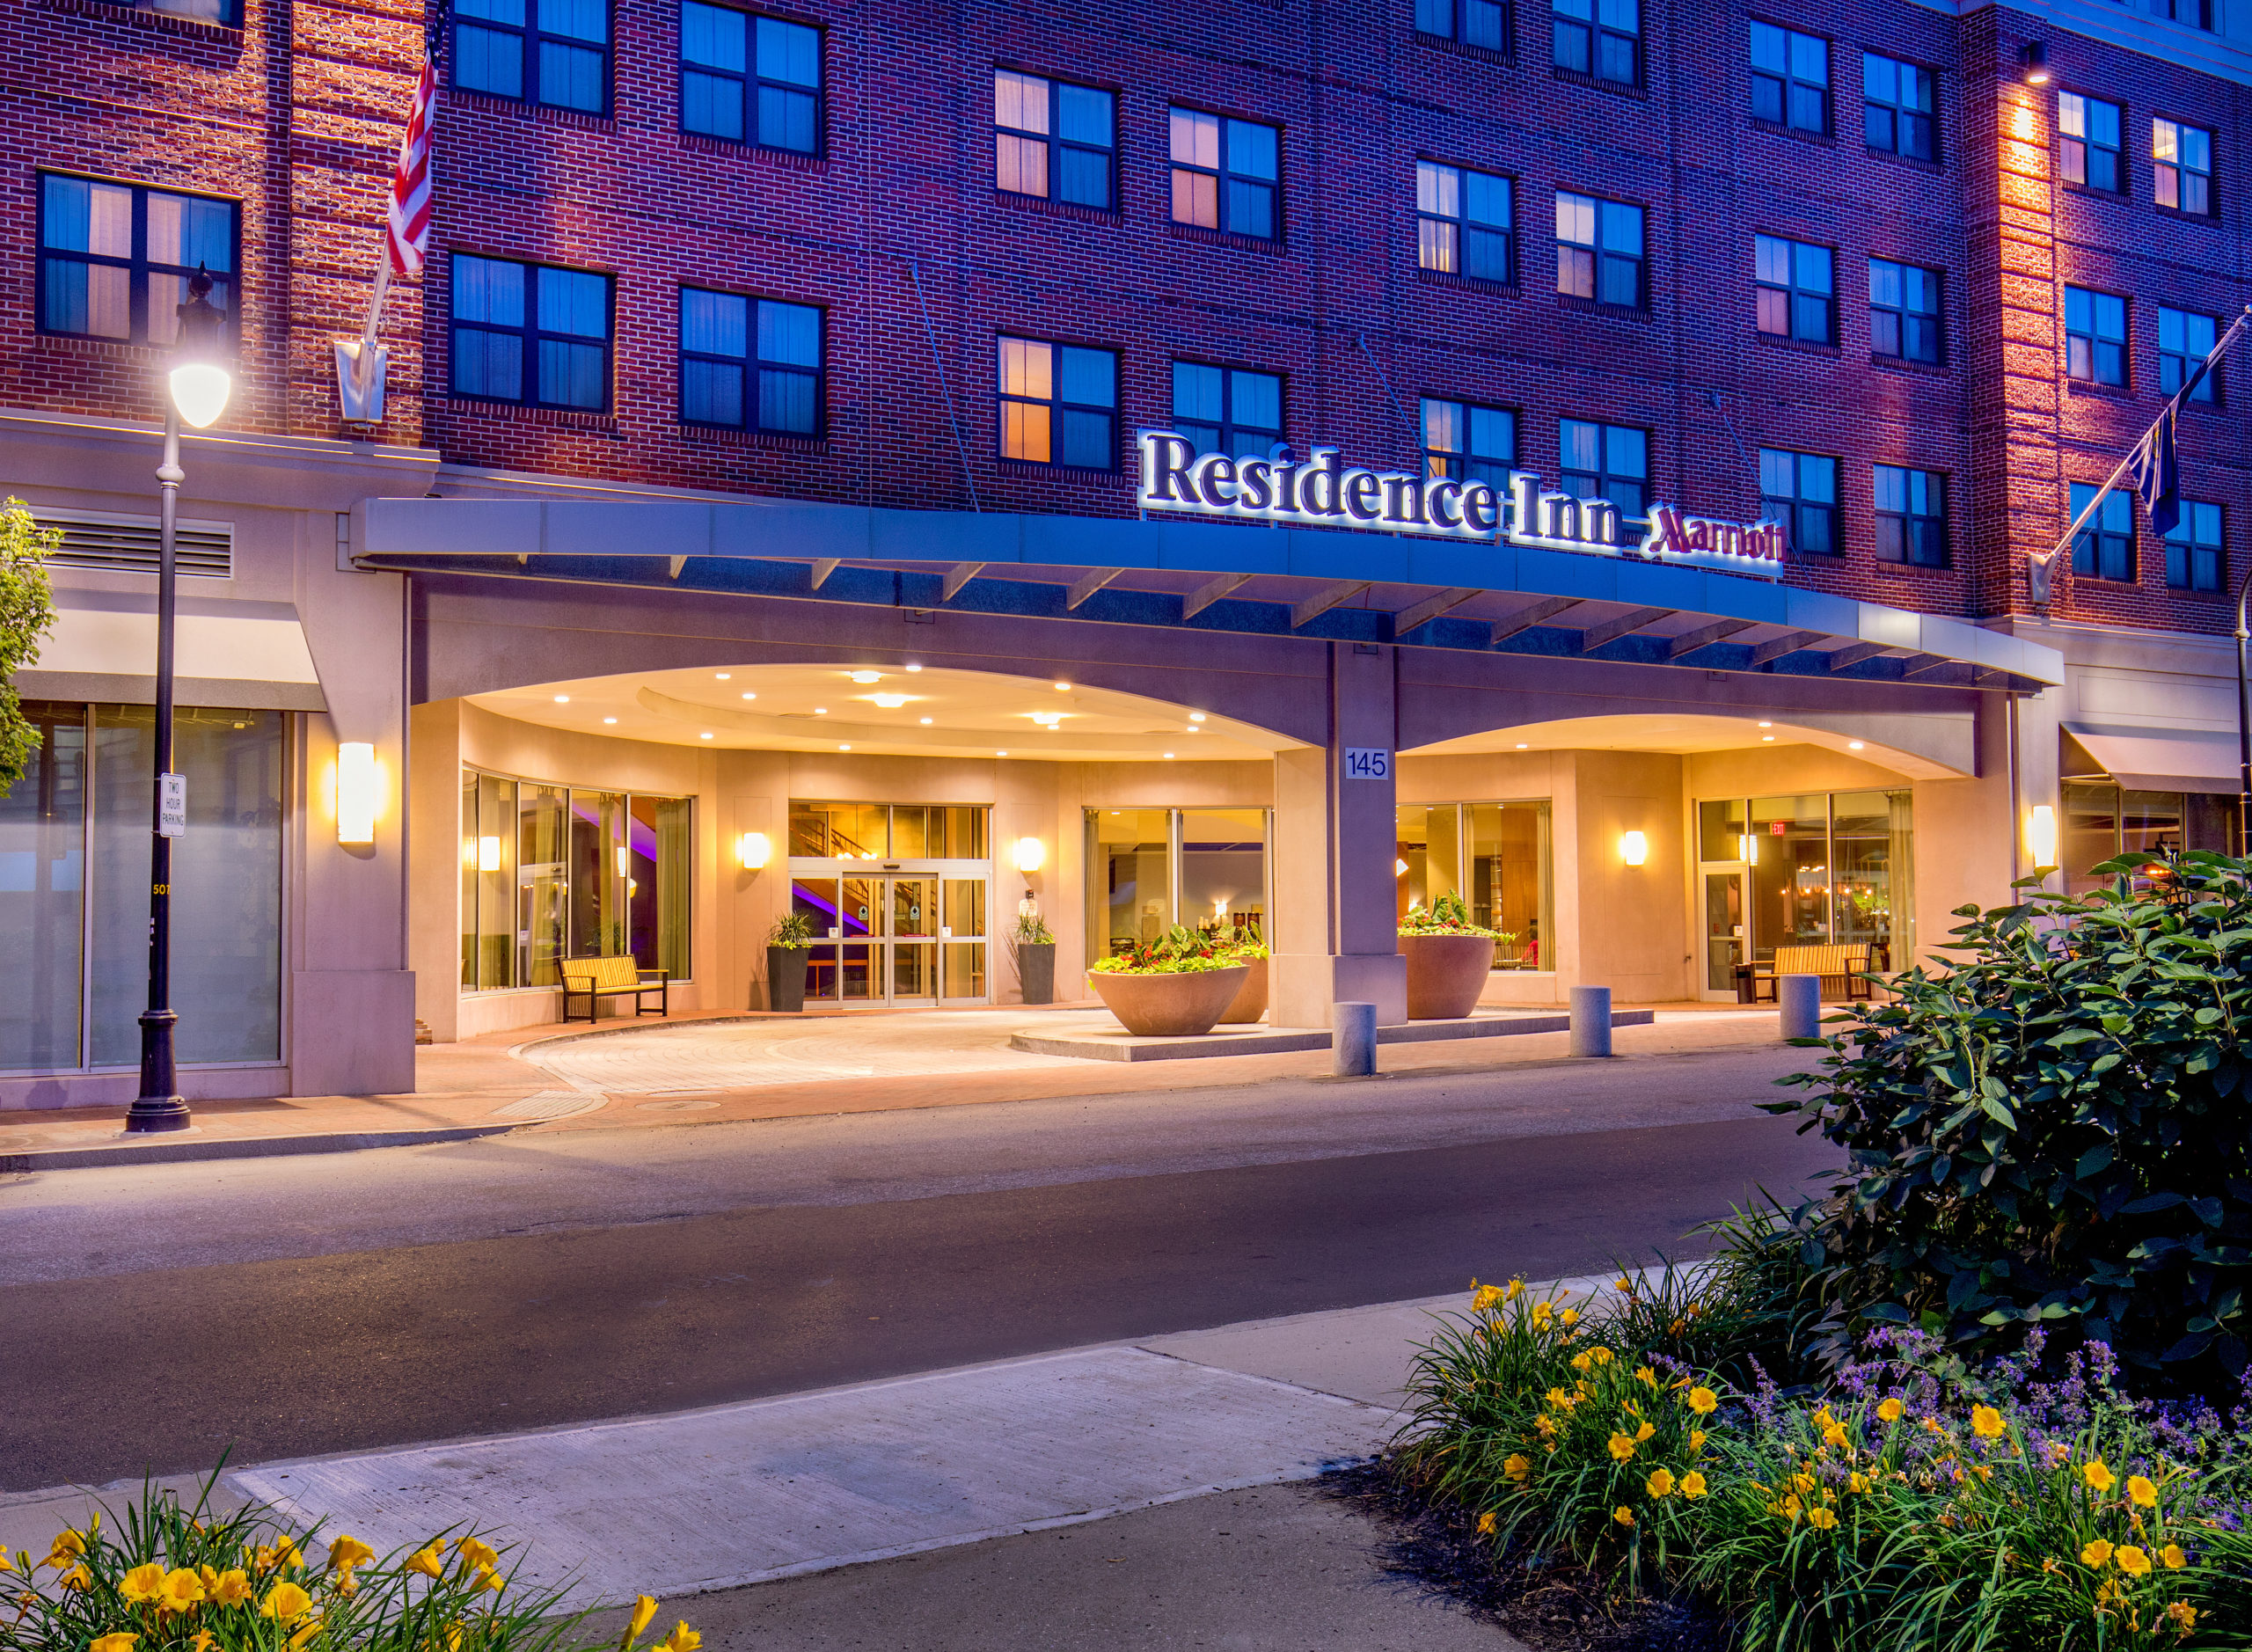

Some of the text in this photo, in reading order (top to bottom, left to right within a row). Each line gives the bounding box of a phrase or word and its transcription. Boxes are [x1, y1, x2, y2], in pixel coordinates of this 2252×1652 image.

[1145, 435, 1788, 563] Residence Inn Marriott
[1348, 751, 1386, 777] 145
[168, 781, 179, 794] TWO
[166, 797, 181, 810] HOUR
[162, 812, 184, 826] PARKING
